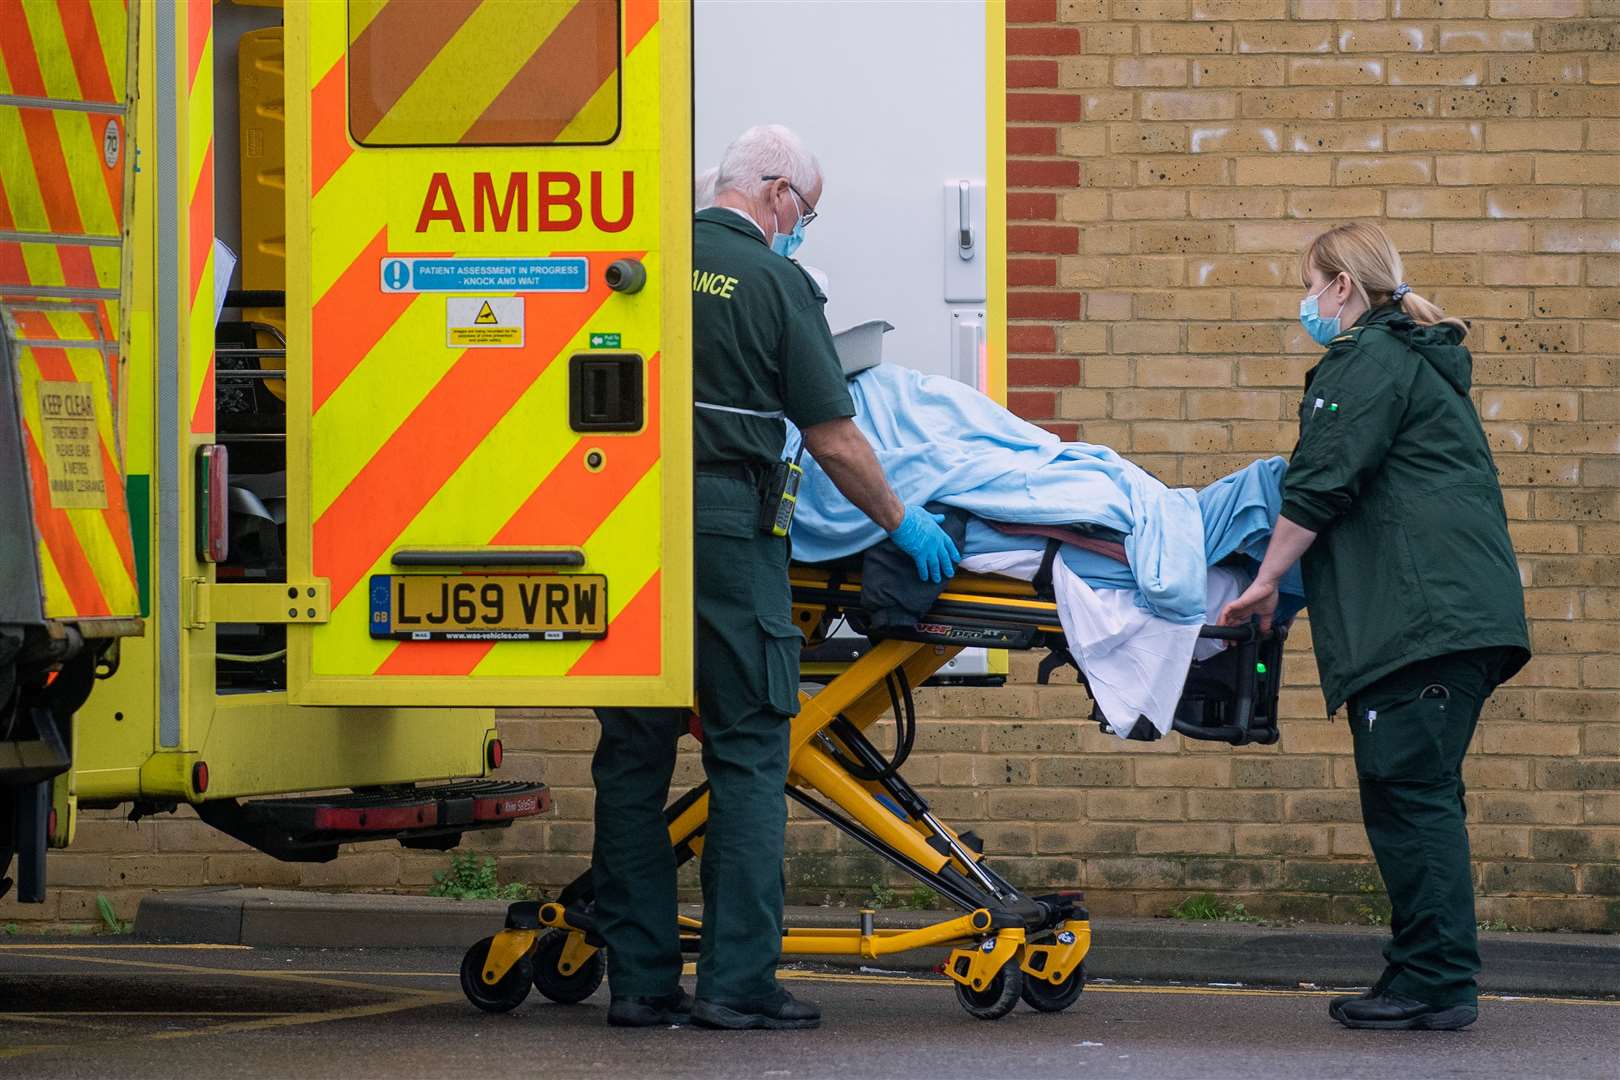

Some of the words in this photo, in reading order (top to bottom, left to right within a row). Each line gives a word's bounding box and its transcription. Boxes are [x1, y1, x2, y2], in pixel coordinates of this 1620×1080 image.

[415, 171, 635, 233] AMBU
[419, 266, 456, 275] PATIENT
[457, 265, 517, 275] ASSESSMENT
[519, 265, 528, 274] IN
[530, 265, 579, 274] PROGRESS
[463, 277, 494, 286] KNOCK
[496, 277, 517, 285] AND
[518, 277, 540, 285] WAIT
[42, 394, 62, 415] KEEP
[65, 394, 93, 416] CLEAR
[397, 583, 504, 625] LJ69
[518, 583, 598, 625] VRW
[373, 611, 388, 623] GB
